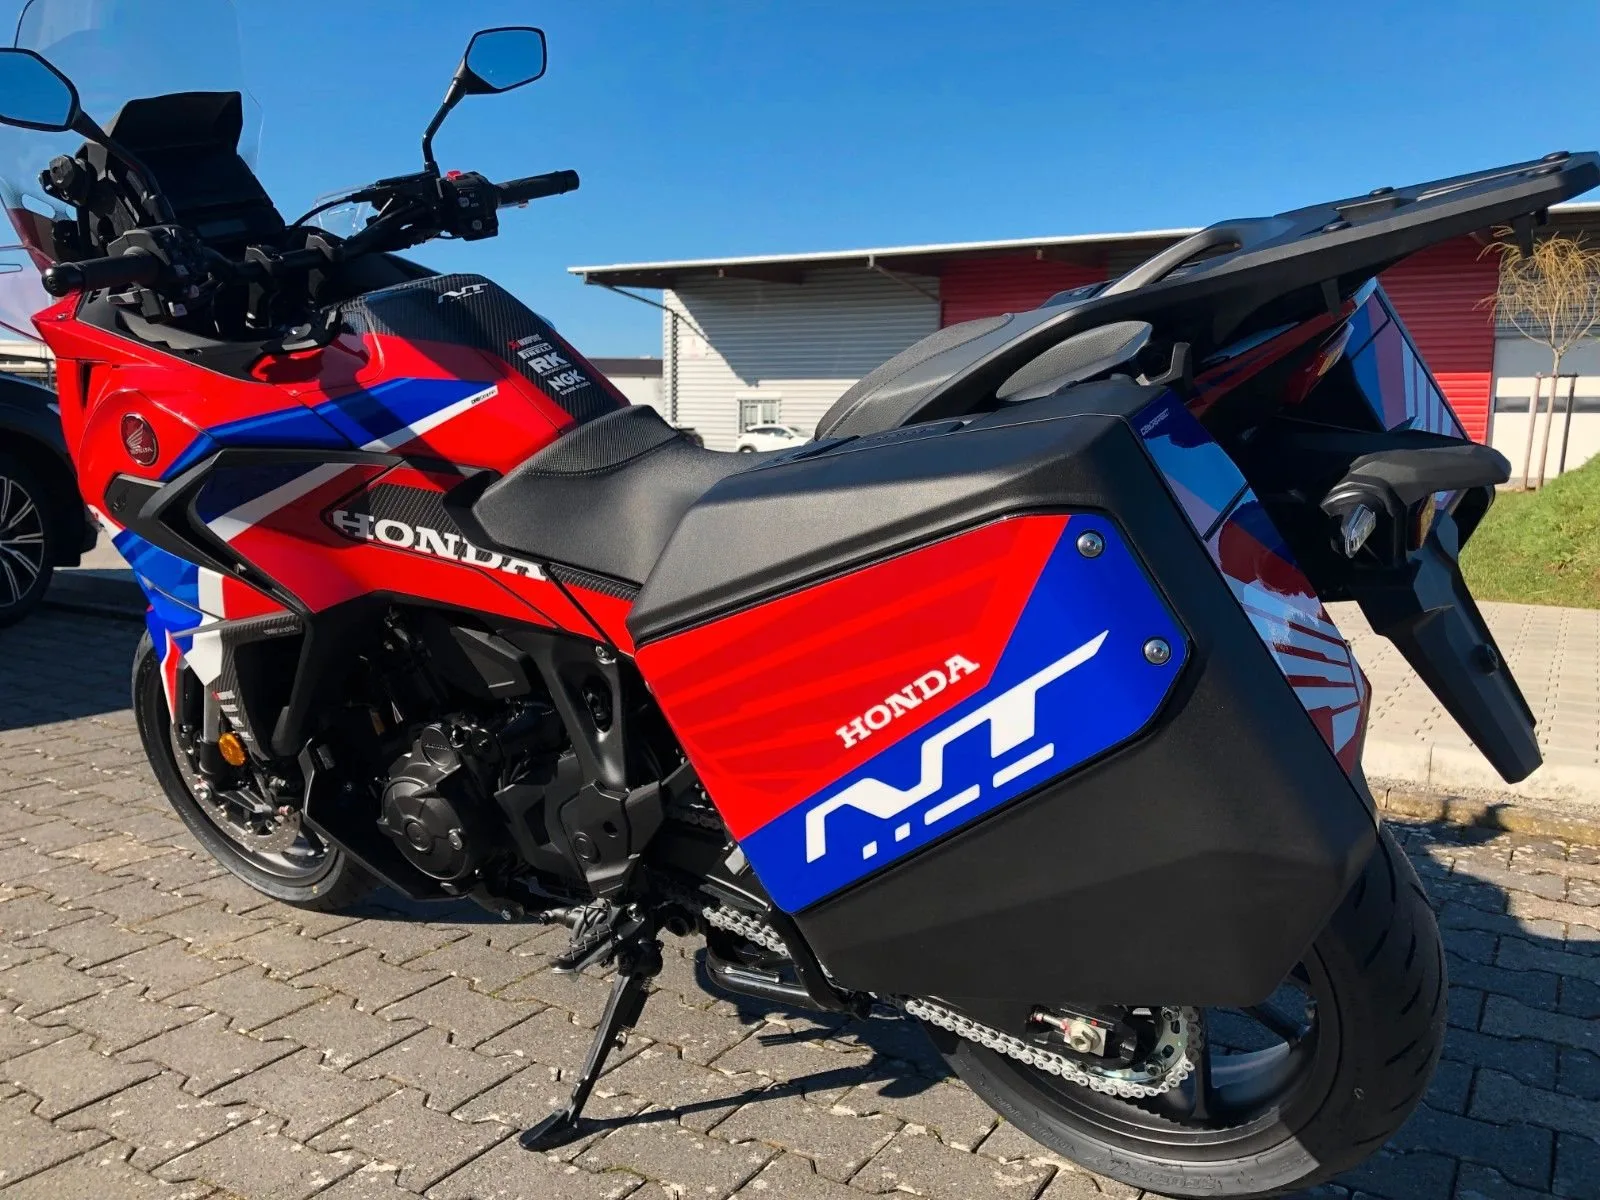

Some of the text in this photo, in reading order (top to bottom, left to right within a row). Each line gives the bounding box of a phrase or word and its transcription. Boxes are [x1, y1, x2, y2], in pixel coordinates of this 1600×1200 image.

[528, 352, 568, 374] RK
[547, 369, 586, 391] NGK
[333, 510, 547, 582] HONDA
[836, 654, 980, 748] HONDA
